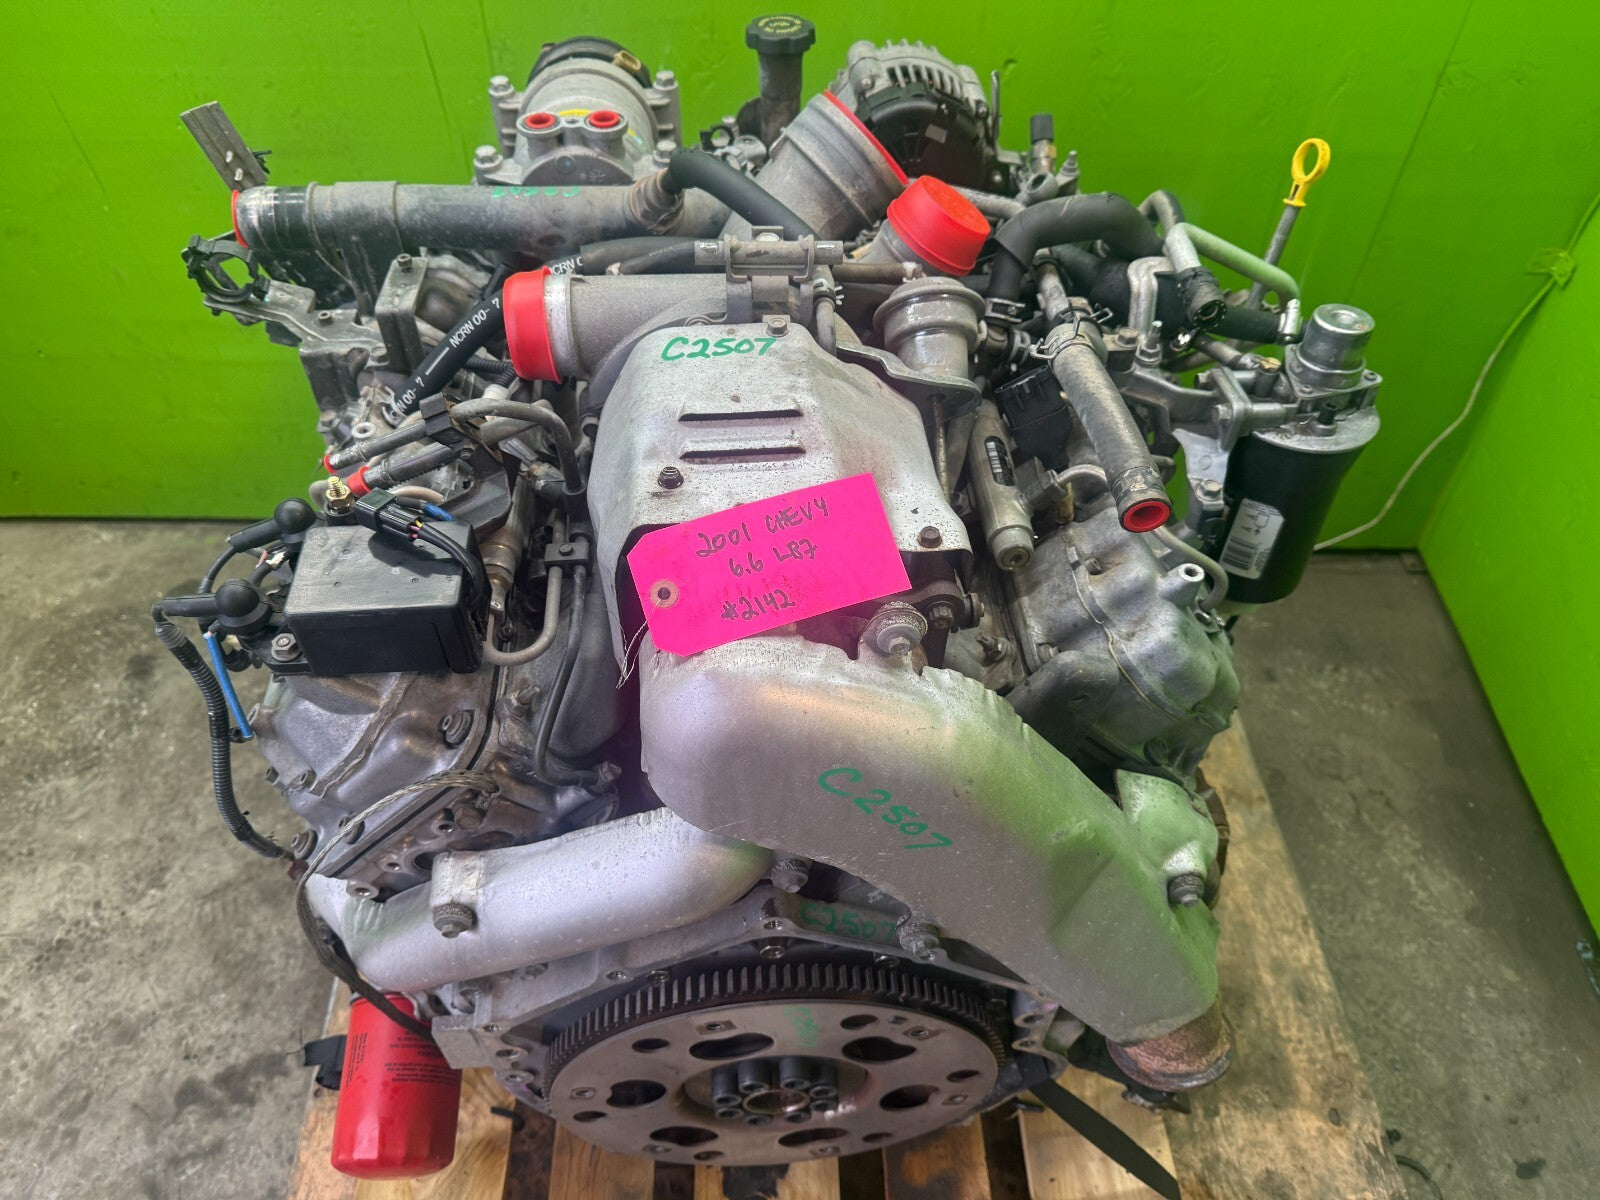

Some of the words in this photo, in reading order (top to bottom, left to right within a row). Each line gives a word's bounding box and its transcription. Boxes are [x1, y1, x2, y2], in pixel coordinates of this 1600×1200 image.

[549, 257, 575, 276] CRN
[449, 320, 475, 348] NCRN
[661, 336, 777, 361] C2507
[696, 523, 751, 558] 2001
[729, 552, 764, 578] 6.6
[773, 538, 818, 563] LB7
[720, 589, 796, 621] #2142
[817, 767, 953, 850] C2507
[801, 903, 897, 942] C2507
